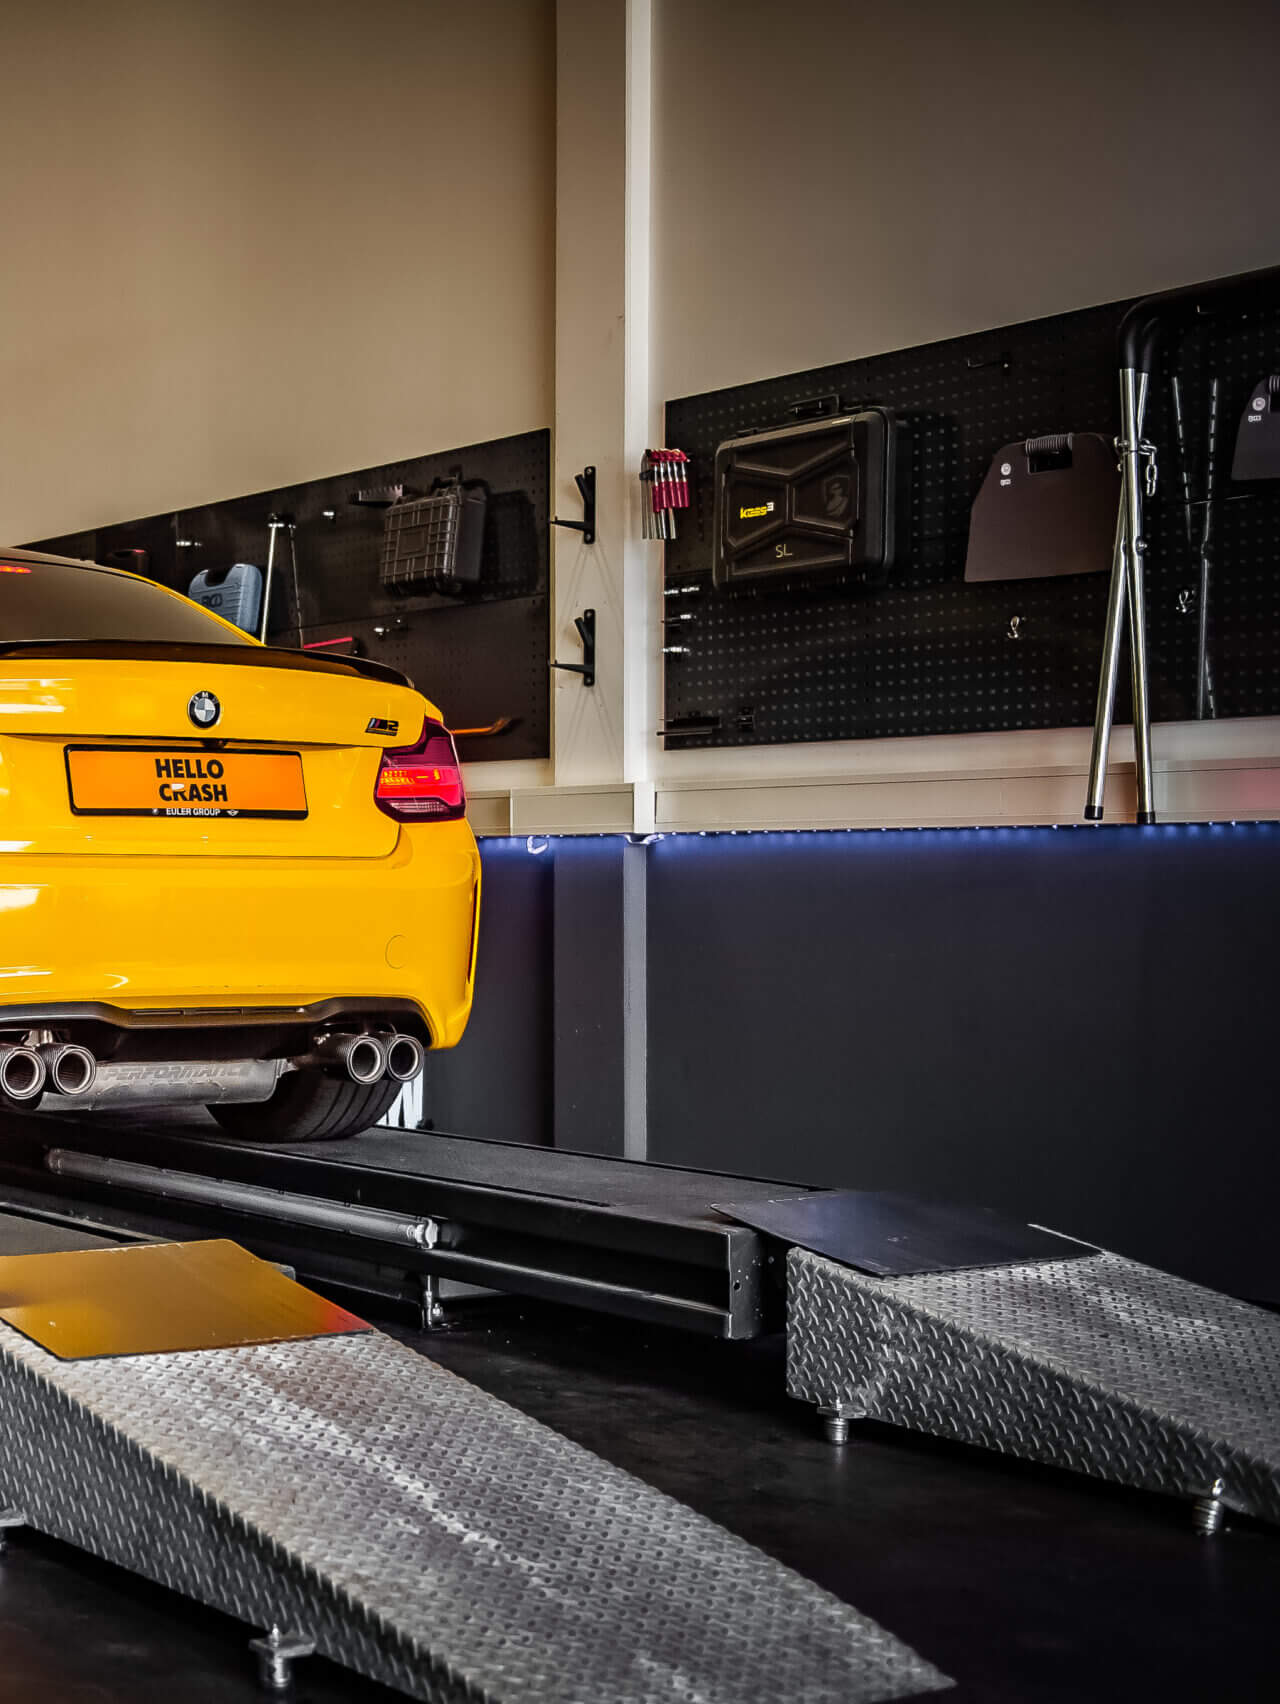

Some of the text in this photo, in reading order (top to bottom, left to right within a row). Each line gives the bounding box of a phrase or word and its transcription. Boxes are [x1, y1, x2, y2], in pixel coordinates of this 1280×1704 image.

[155, 758, 225, 779] HELLO
[166, 808, 221, 817] EULER GROUP
